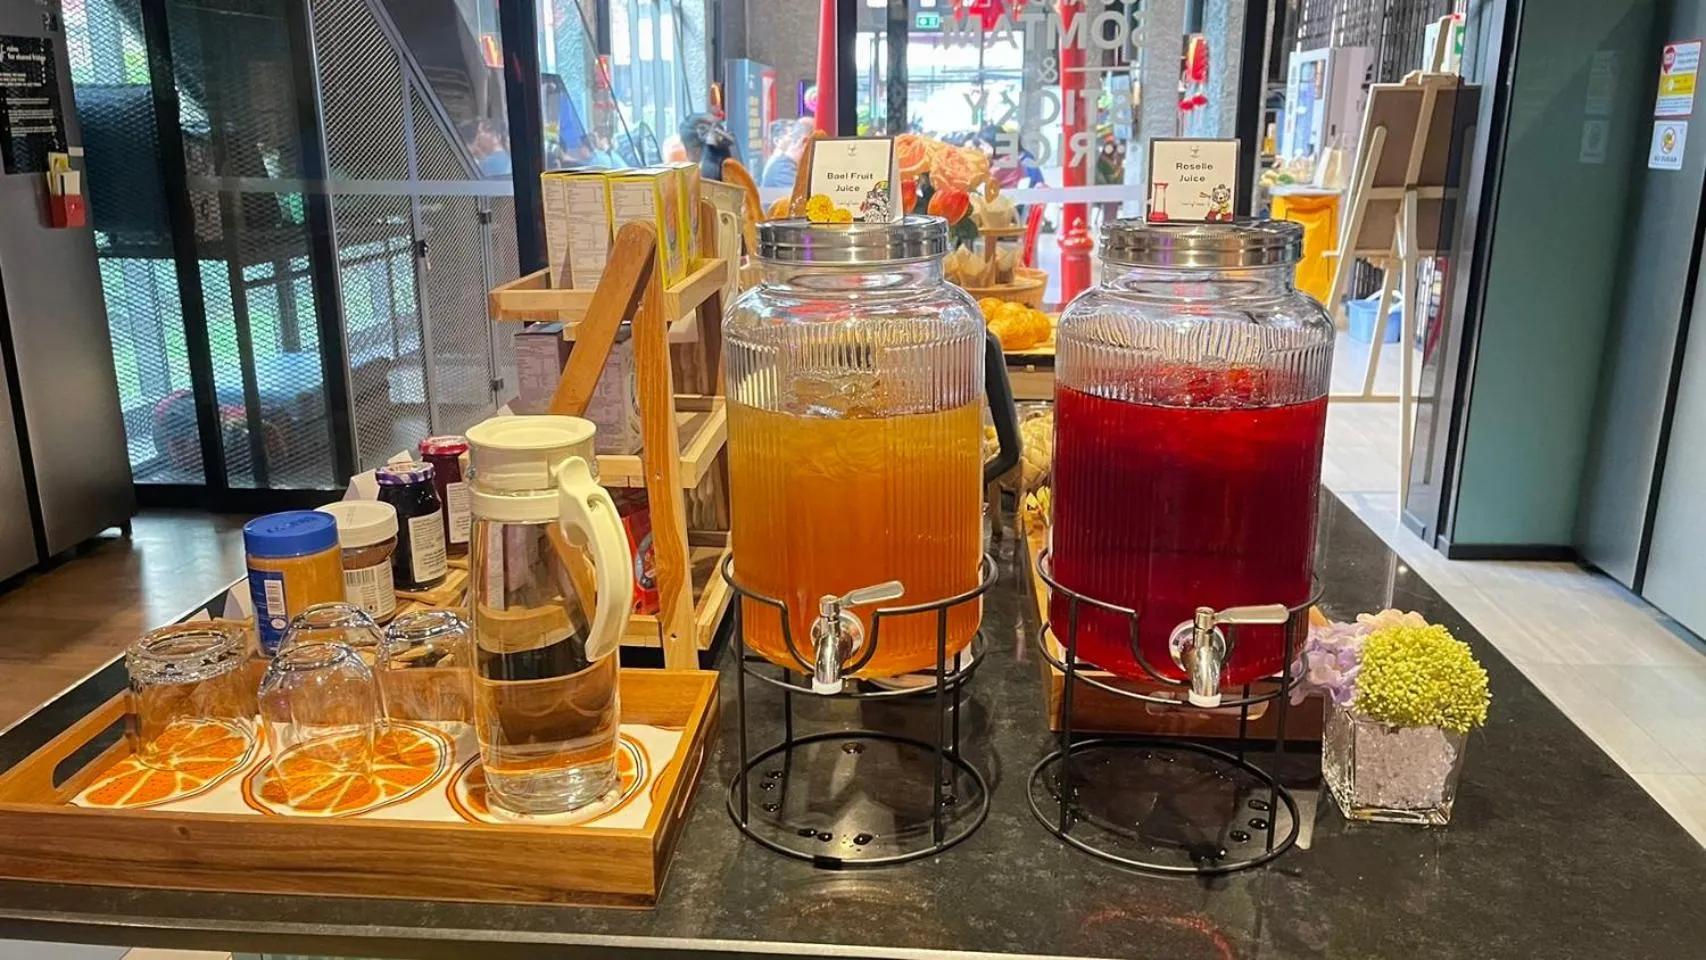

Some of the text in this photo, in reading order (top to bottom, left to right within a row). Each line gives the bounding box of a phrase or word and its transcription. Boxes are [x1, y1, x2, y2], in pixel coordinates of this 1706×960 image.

[850, 172, 874, 180] Fruit
[1179, 174, 1206, 182] Juice
[835, 184, 861, 192] Juice
